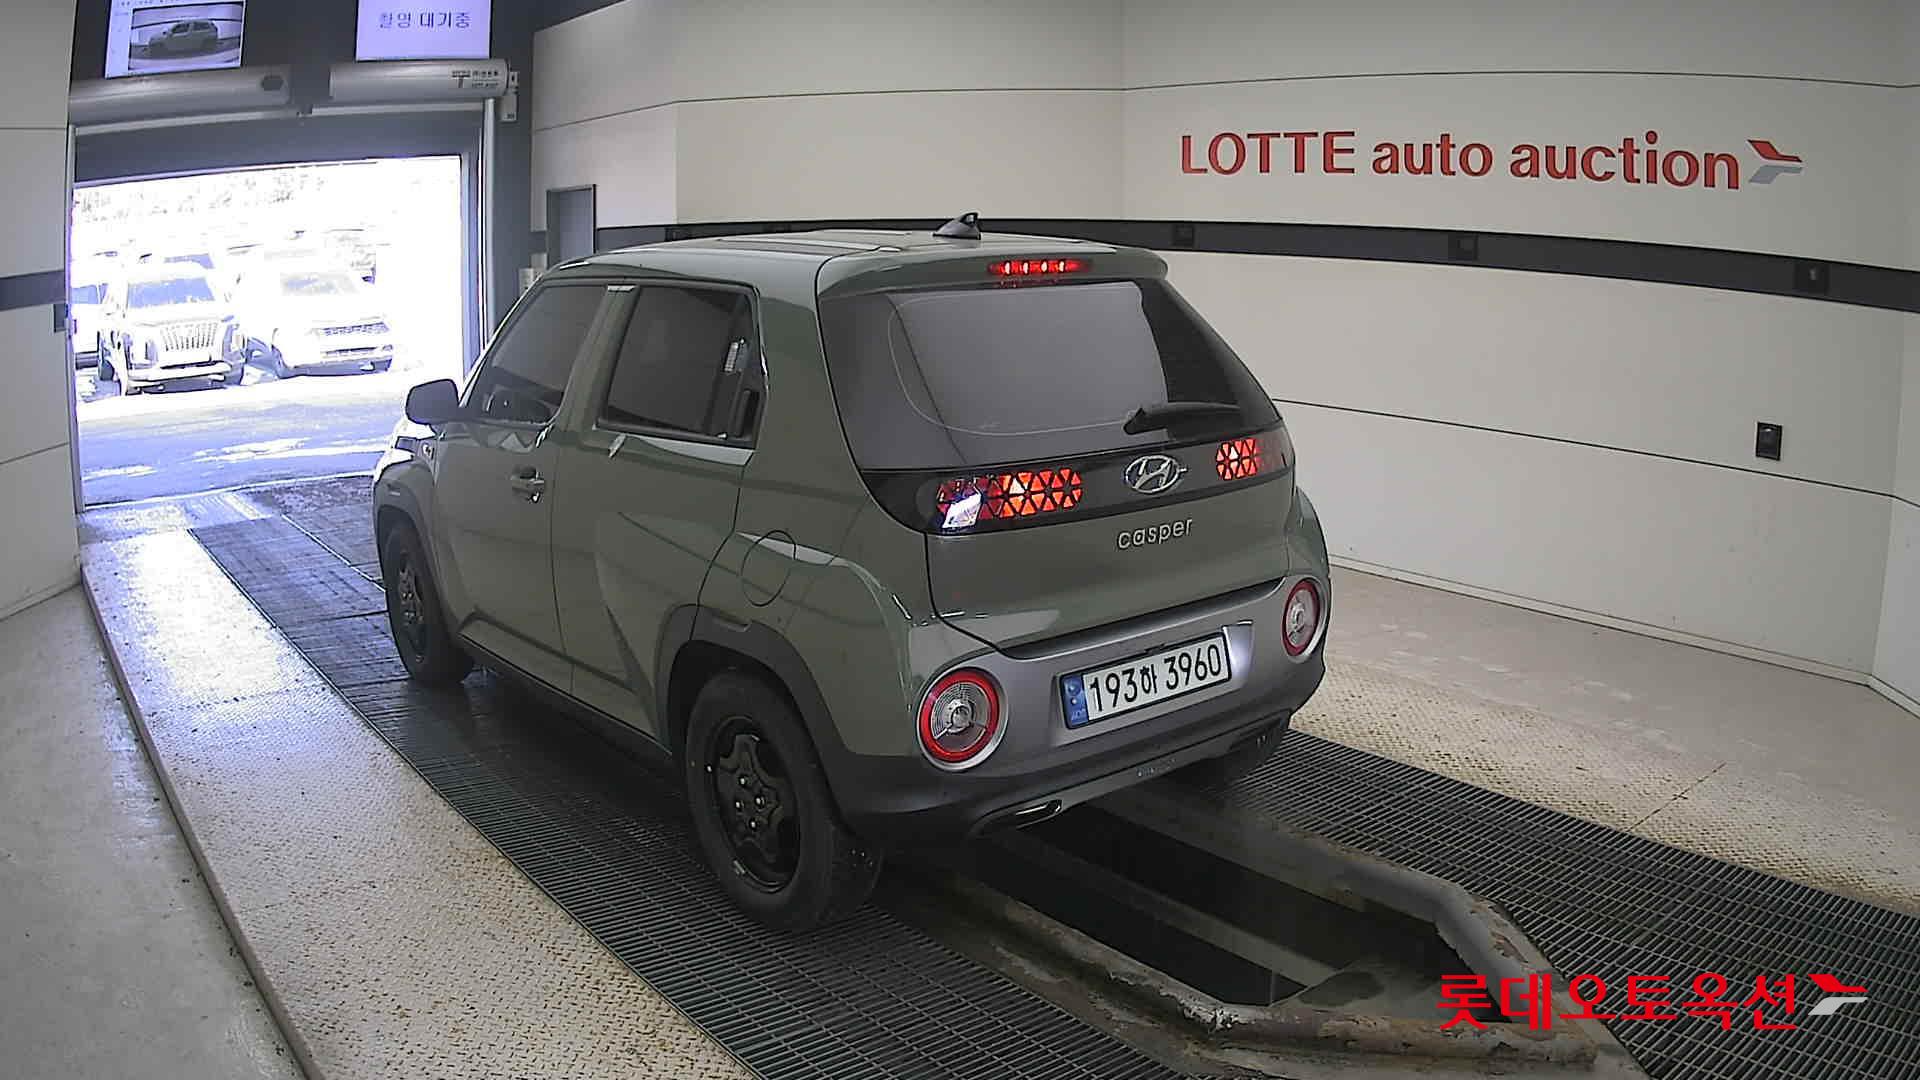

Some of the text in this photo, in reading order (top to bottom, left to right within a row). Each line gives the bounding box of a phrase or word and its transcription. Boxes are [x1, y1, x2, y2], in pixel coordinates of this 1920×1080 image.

[420, 11, 471, 29] 대기중
[1181, 130, 1739, 190] LOTTE auto auction
[1117, 519, 1192, 549] casper
[1090, 644, 1221, 712] 193하 3960
